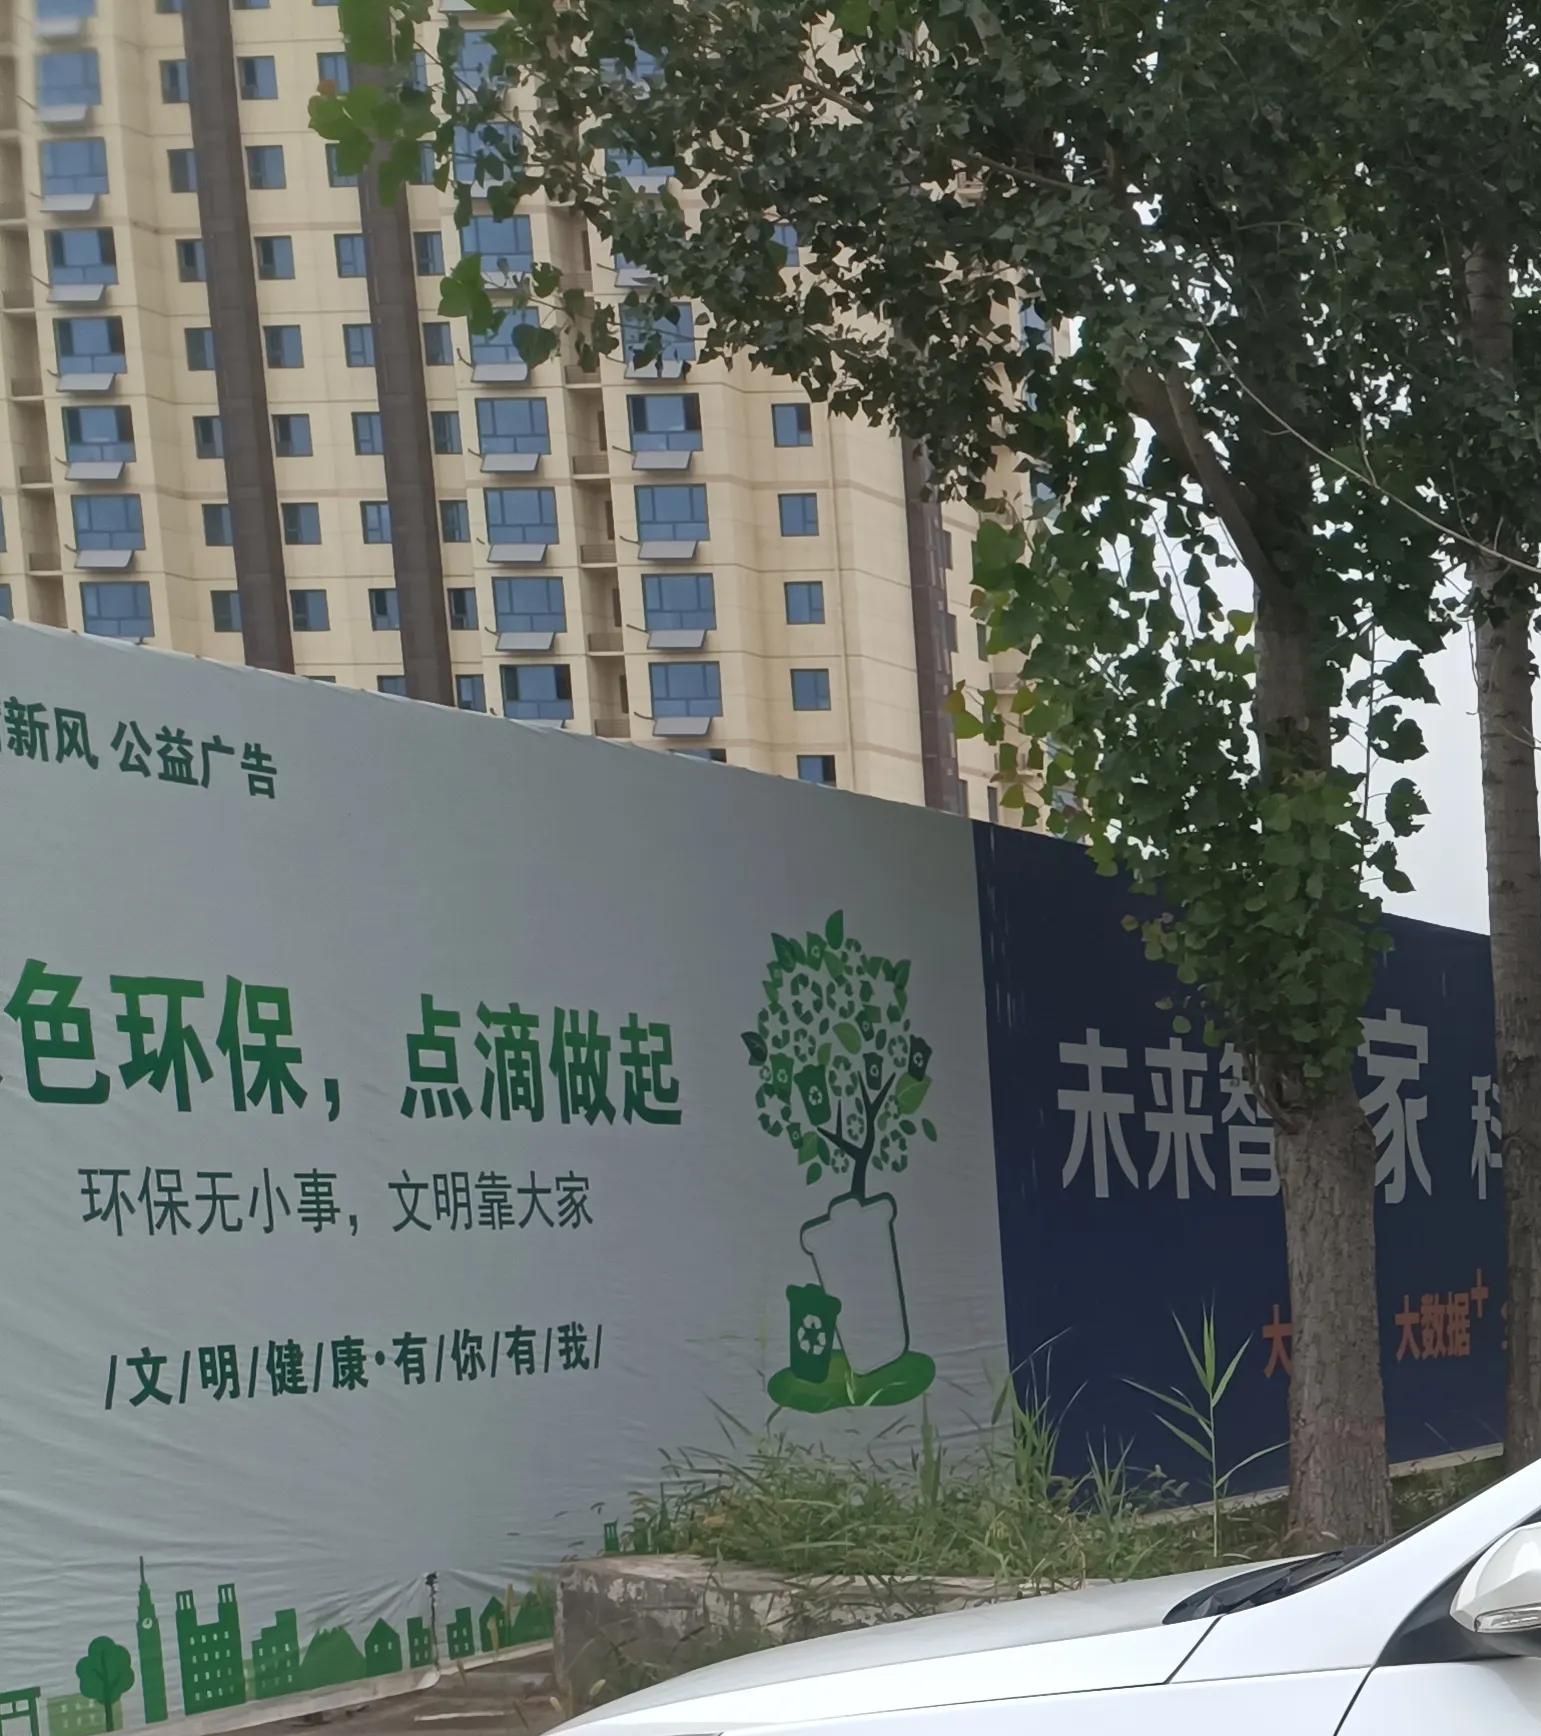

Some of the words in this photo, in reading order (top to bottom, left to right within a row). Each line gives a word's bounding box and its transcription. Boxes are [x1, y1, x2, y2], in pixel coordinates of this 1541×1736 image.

[0, 696, 99, 770] 新风
[110, 720, 277, 799] 公益广告
[0, 958, 683, 1126] 色环保，点滴做起
[1057, 1008, 1432, 1204] 未来智家
[78, 1166, 593, 1236] 环保无小事，文明靠大家
